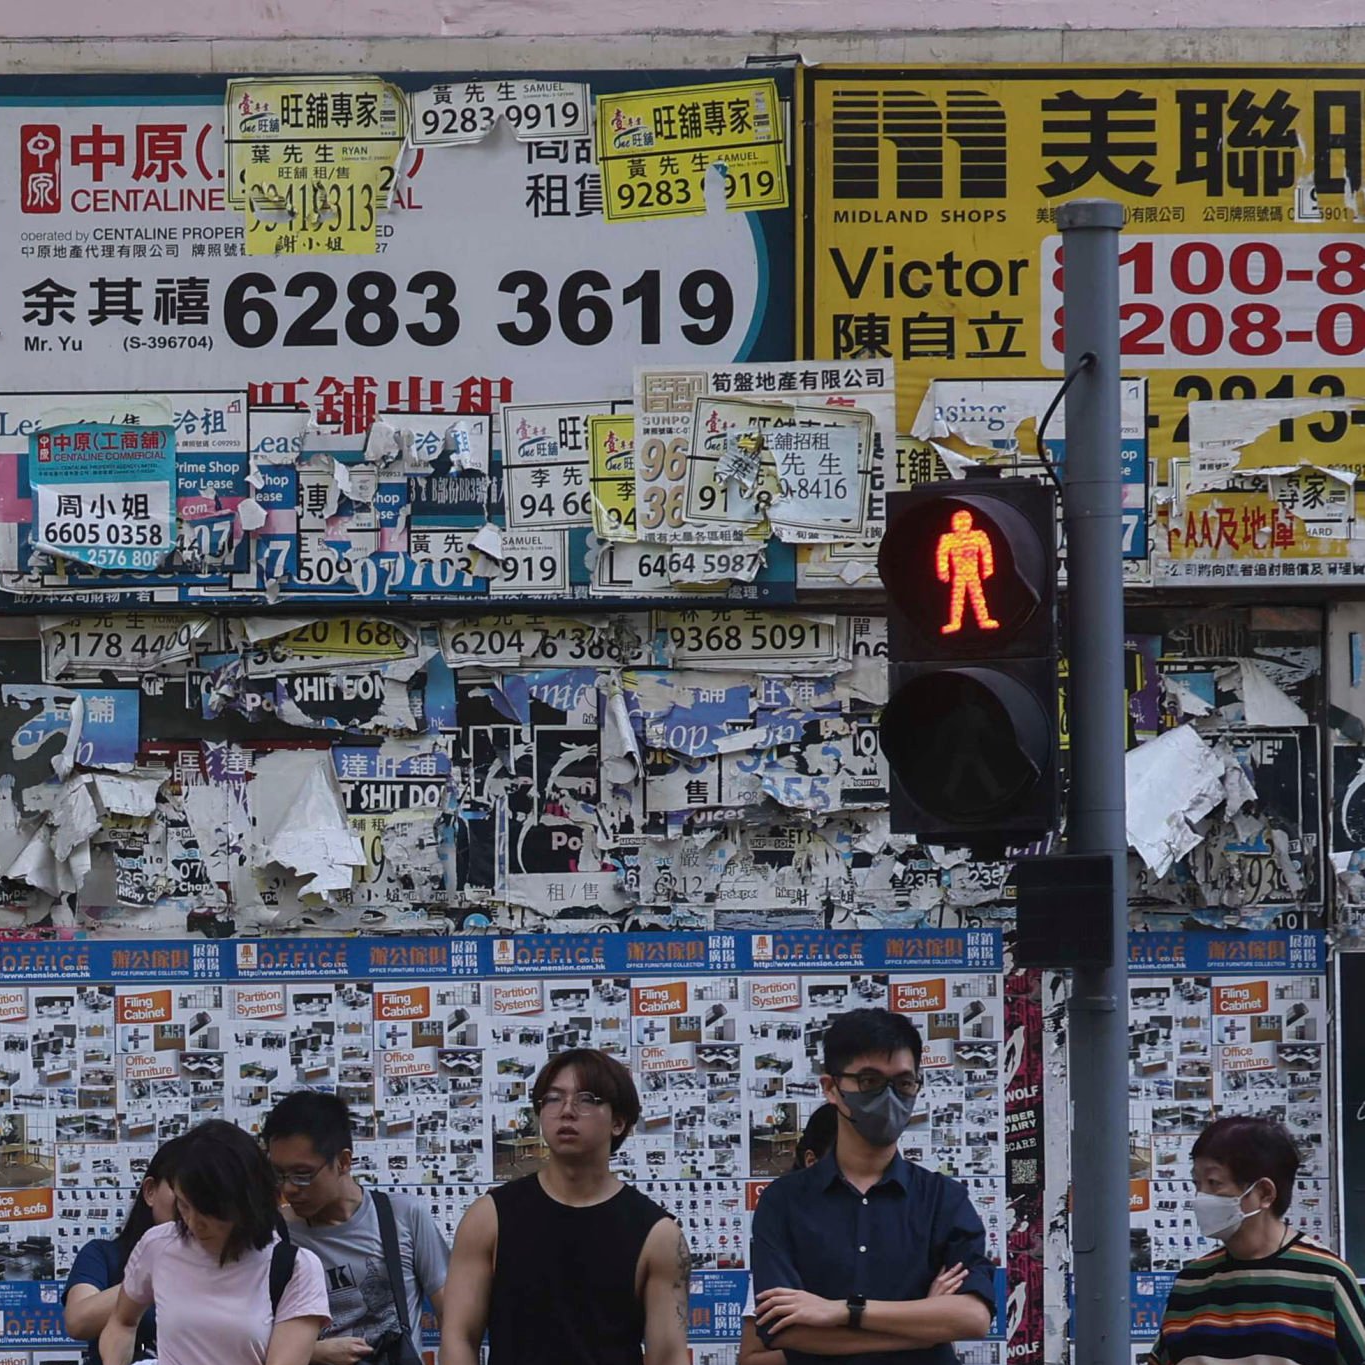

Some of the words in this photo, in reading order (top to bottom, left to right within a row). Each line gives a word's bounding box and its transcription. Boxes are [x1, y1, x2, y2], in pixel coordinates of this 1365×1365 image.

[433, 83, 518, 104] 黃先生
[523, 82, 564, 94] SAMUEL
[281, 92, 378, 130] 旺舖專家
[421, 108, 495, 135] 9283
[504, 101, 580, 130] 9919
[654, 98, 752, 140] 旺舖專家
[251, 143, 335, 164] 葉先生
[342, 146, 368, 155] RYAN
[71, 190, 225, 213] CENTALINE
[617, 178, 692, 210] 9283
[833, 209, 928, 223] MIDLAND
[941, 209, 1007, 223] SHOPS
[20, 231, 65, 244] operated
[68, 230, 89, 243] by
[93, 228, 179, 241] CENTALINE
[21, 243, 179, 259] 中原地產代理有限公司
[830, 246, 1029, 299] Victor
[22, 277, 210, 328] 余其禧
[223, 270, 460, 348] 6283
[496, 269, 734, 347] 3619
[24, 336, 53, 352] Mr.
[59, 336, 83, 352] Yu
[123, 335, 214, 352] (S-396704)
[832, 311, 1027, 360] 陳自立
[56, 493, 150, 521] 周小姐
[44, 522, 100, 545] 6605
[106, 523, 163, 546] 0358
[450, 631, 525, 657] 6204
[671, 625, 743, 652] 9368
[751, 622, 823, 650] 5091
[1, 954, 90, 969] OFFICE
[123, 997, 154, 1009] Filing
[123, 1008, 166, 1021] Cabinet
[125, 1055, 157, 1067] Office
[125, 1066, 174, 1078] Furniture
[23, 1204, 48, 1217] sofa
